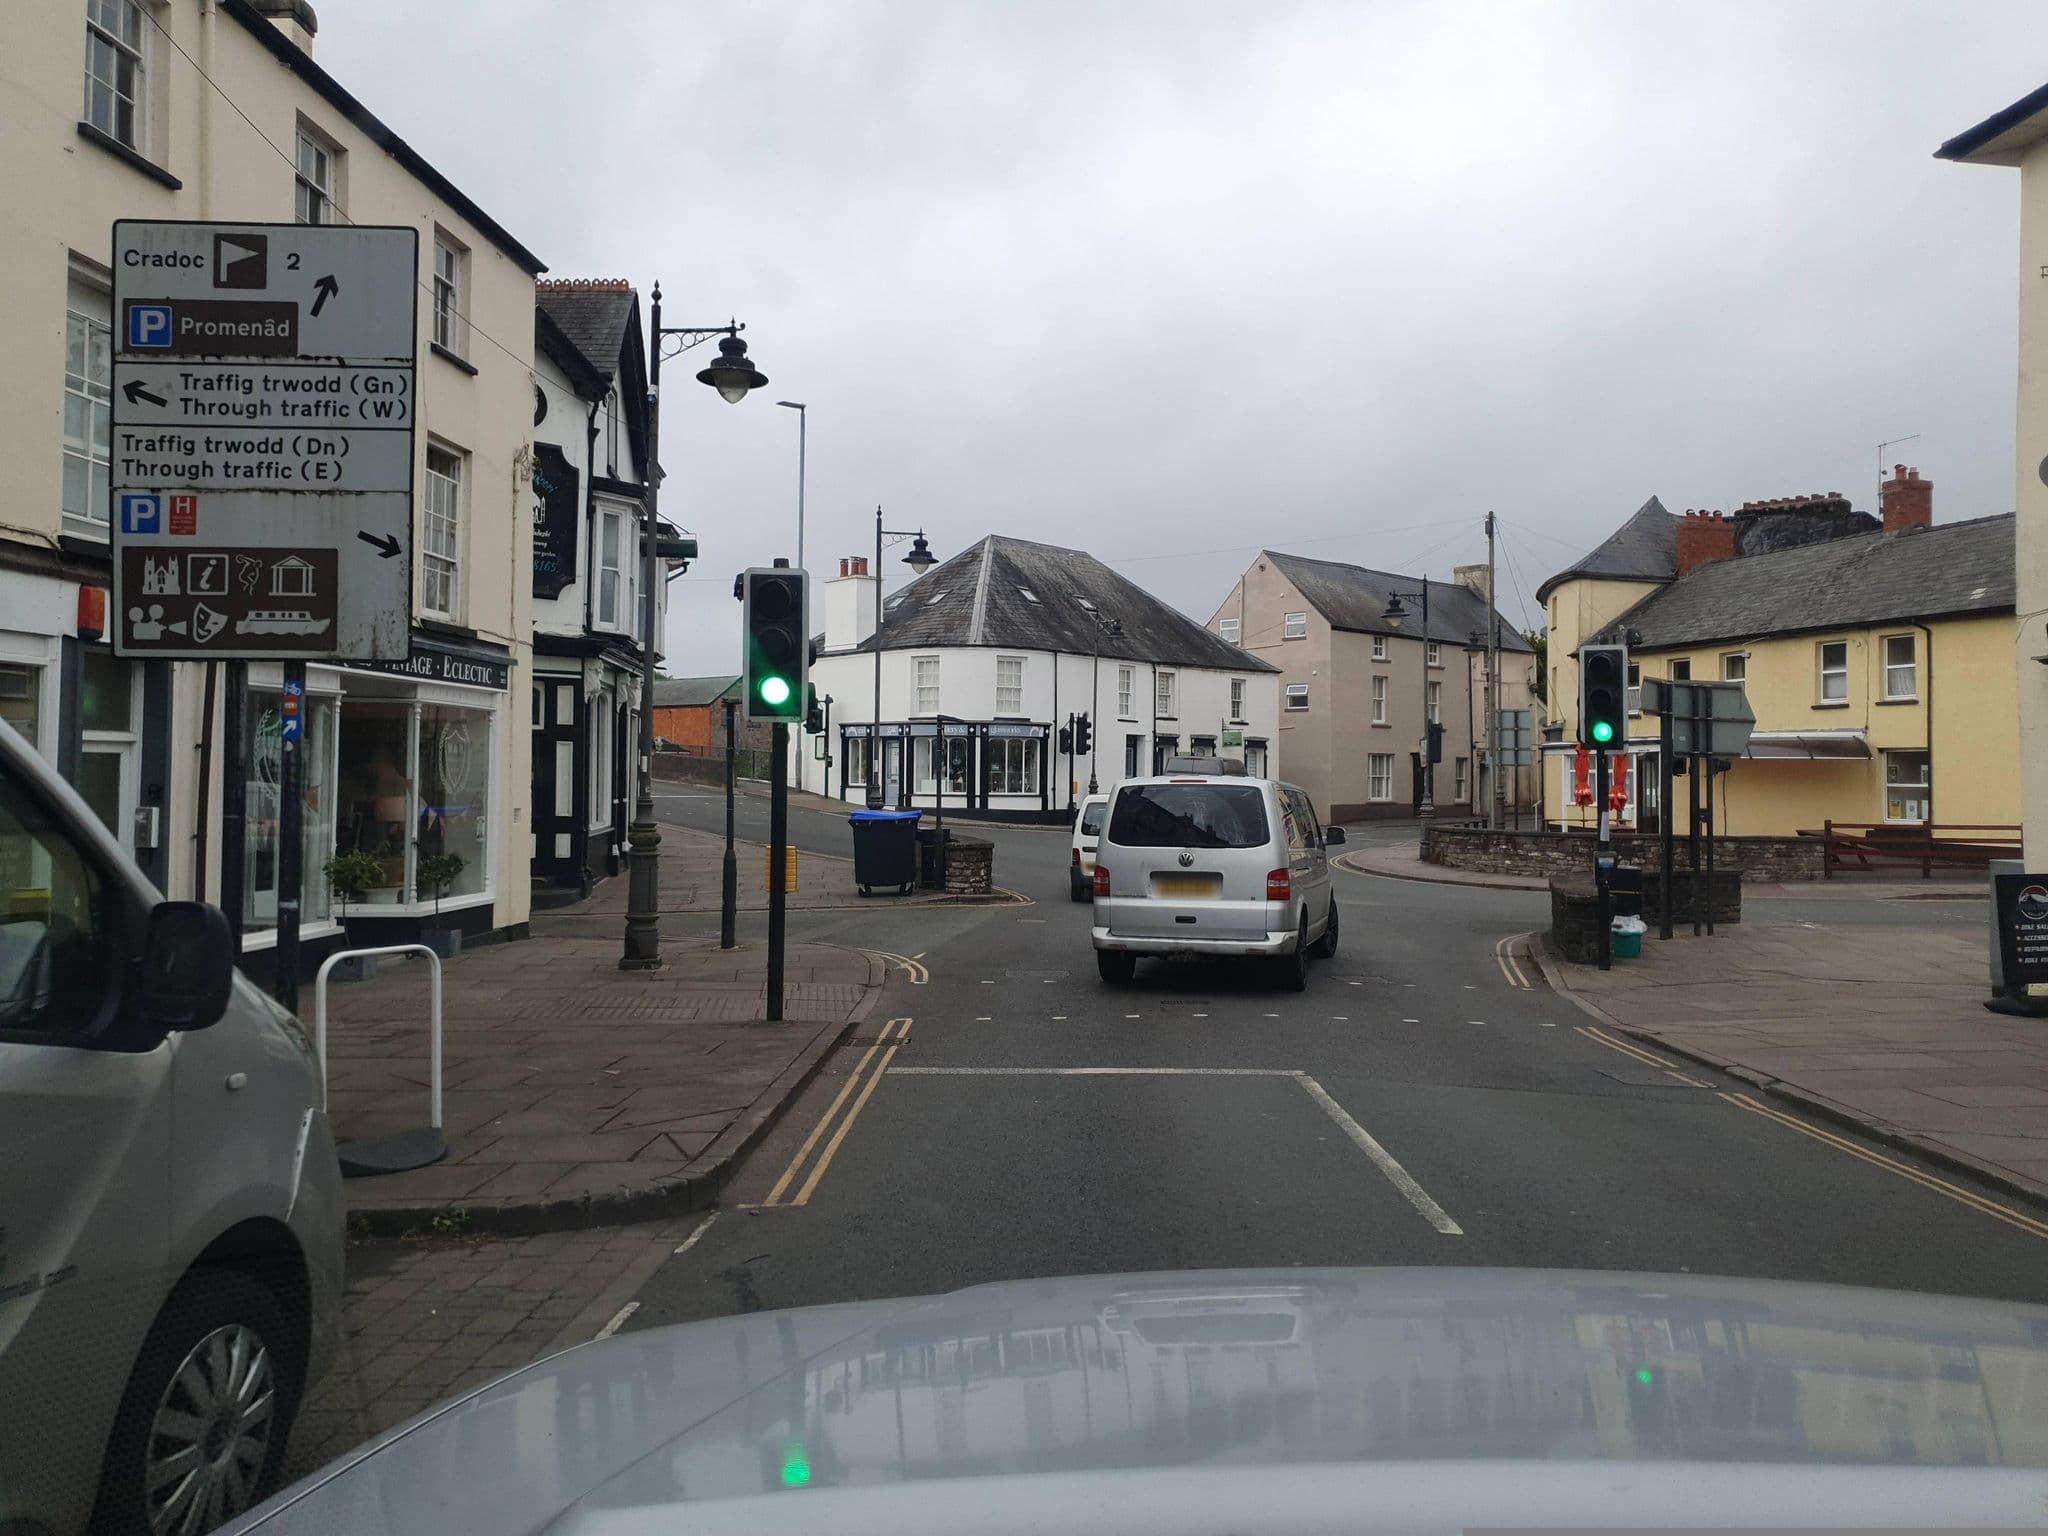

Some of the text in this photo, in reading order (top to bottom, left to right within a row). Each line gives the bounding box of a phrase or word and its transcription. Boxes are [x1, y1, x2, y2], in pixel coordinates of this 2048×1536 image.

[123, 248, 205, 268] Cradoc
[286, 252, 301, 270] 2
[139, 310, 166, 343] P
[180, 317, 290, 338] Promenâd
[180, 373, 408, 396] Traffig trwodd (Gn)
[180, 398, 408, 420] Through traffic (W)
[121, 434, 350, 458] Traffig trwodd (Dn)
[121, 459, 343, 482] Through traffic (E)
[130, 498, 156, 532] P
[176, 496, 191, 514] H
[442, 655, 494, 684] ECLECTIC
